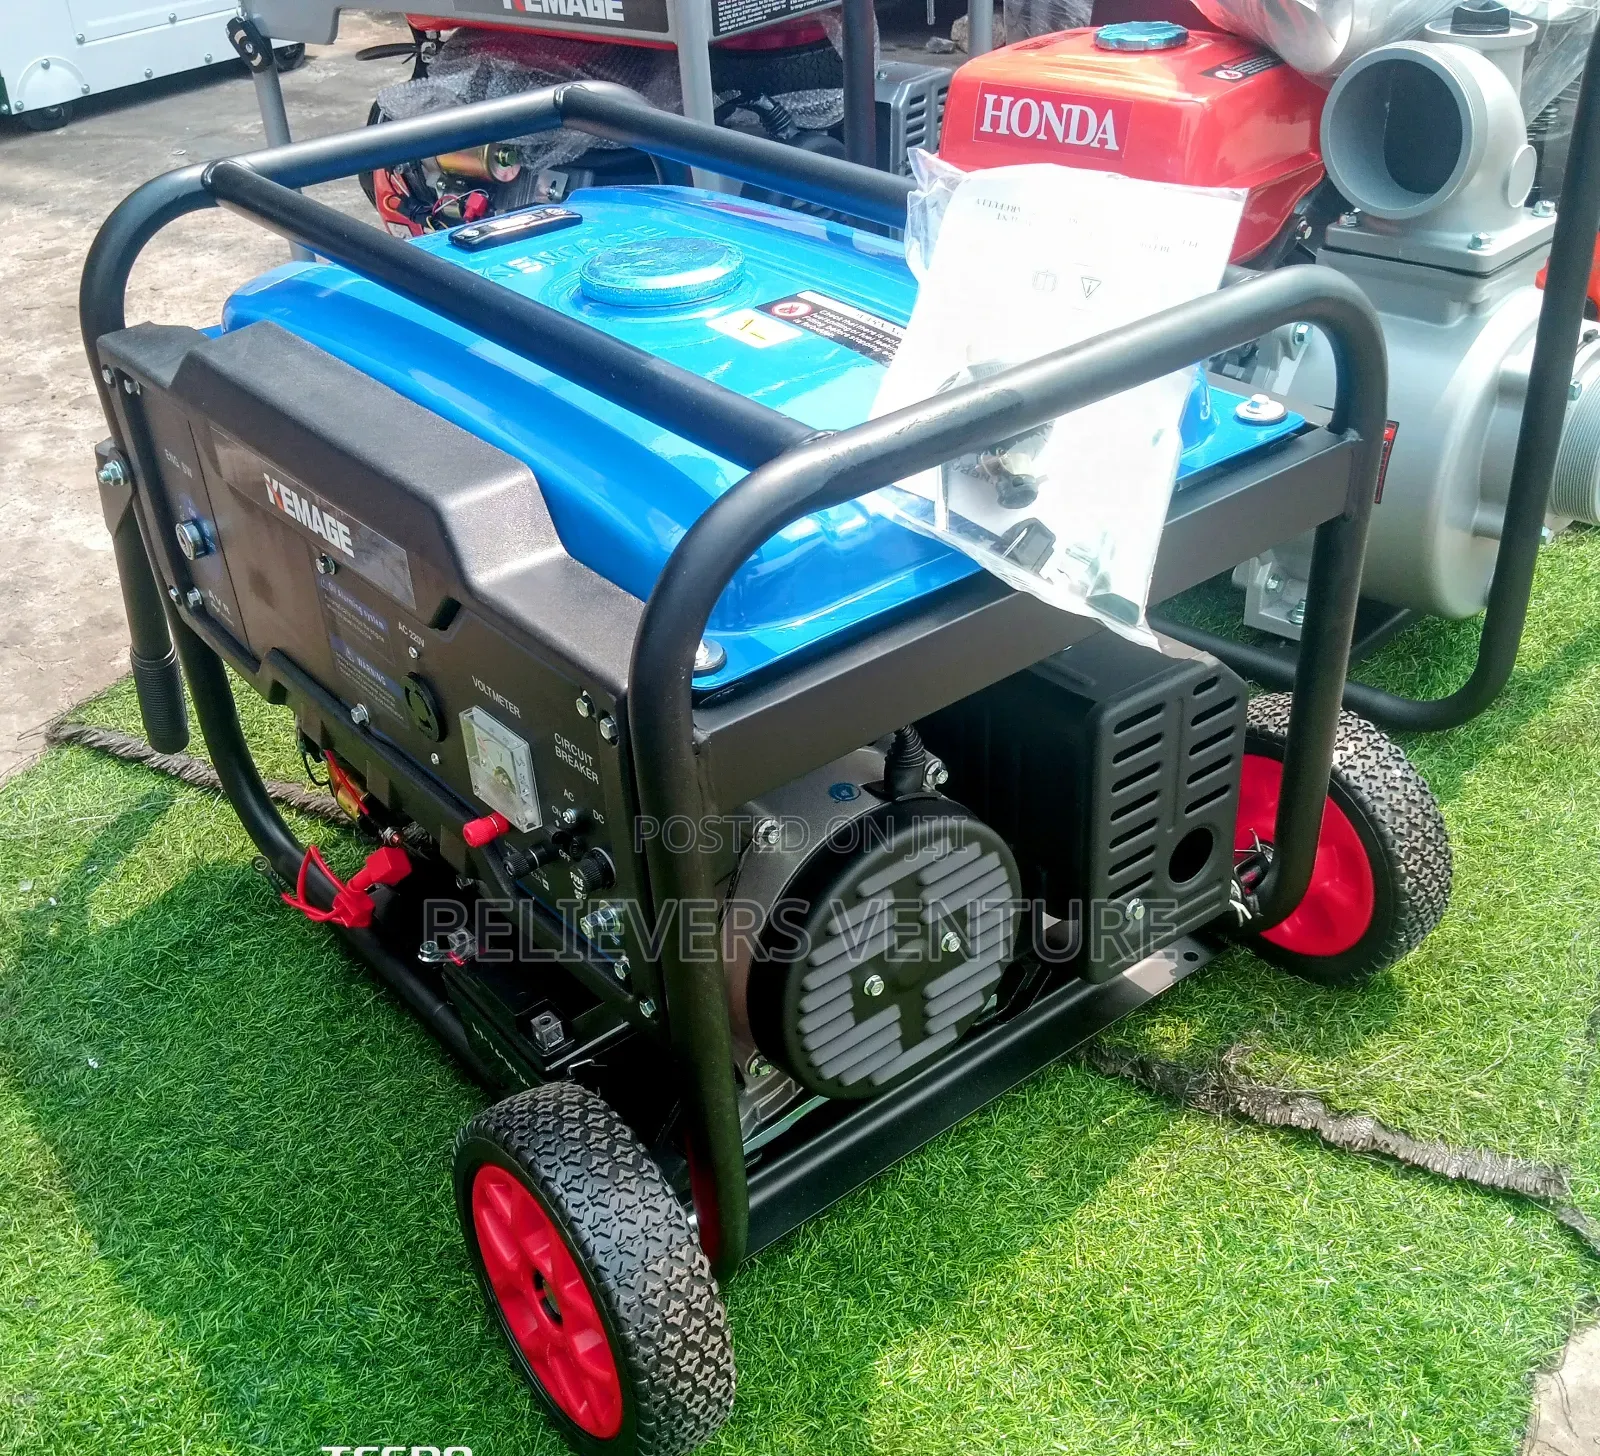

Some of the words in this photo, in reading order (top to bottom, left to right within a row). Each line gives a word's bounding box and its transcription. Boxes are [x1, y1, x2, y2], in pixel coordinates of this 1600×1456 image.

[980, 94, 1119, 150] HONDA
[263, 472, 355, 558] KEMAGE
[471, 675, 522, 719] VOLTMETER
[554, 732, 594, 767] CIRCUIT
[555, 745, 599, 785] BREAKER
[563, 788, 575, 802] AC
[592, 808, 605, 824] DC
